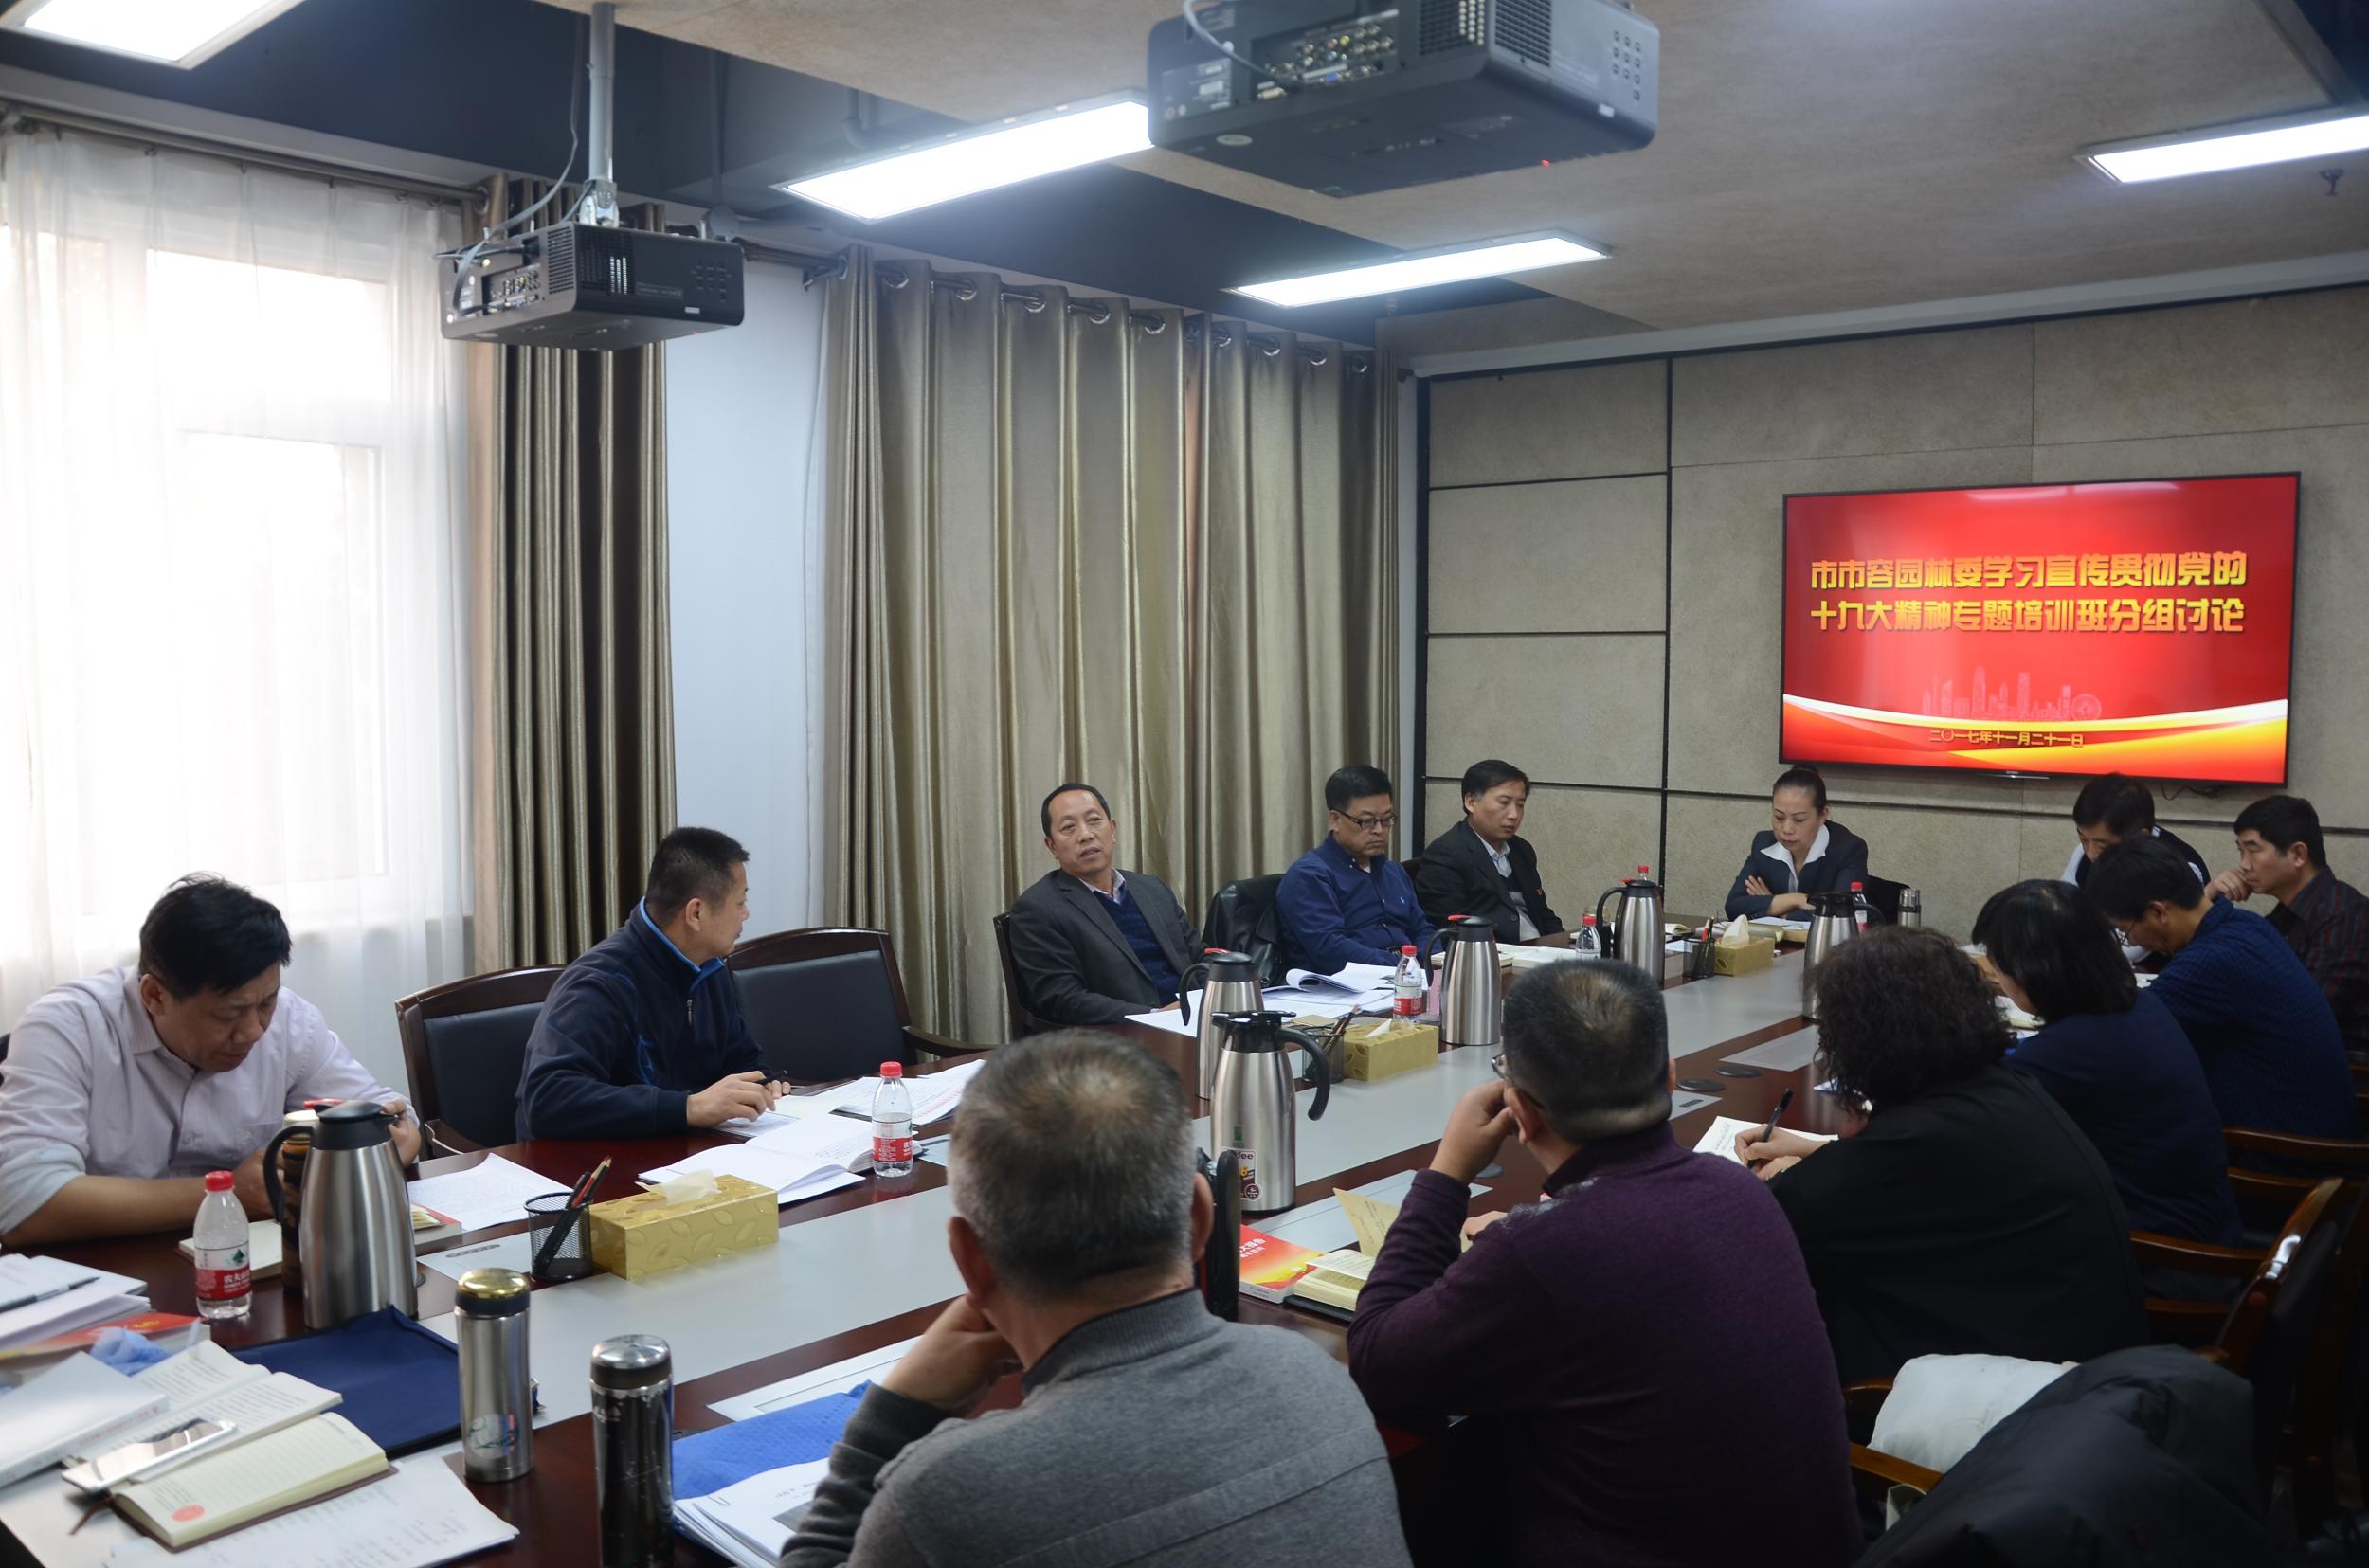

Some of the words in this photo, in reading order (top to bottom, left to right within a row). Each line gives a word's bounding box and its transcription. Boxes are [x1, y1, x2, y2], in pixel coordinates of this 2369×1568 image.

[1810, 598, 2244, 632] 十九大精神专题培训班分组讨论
